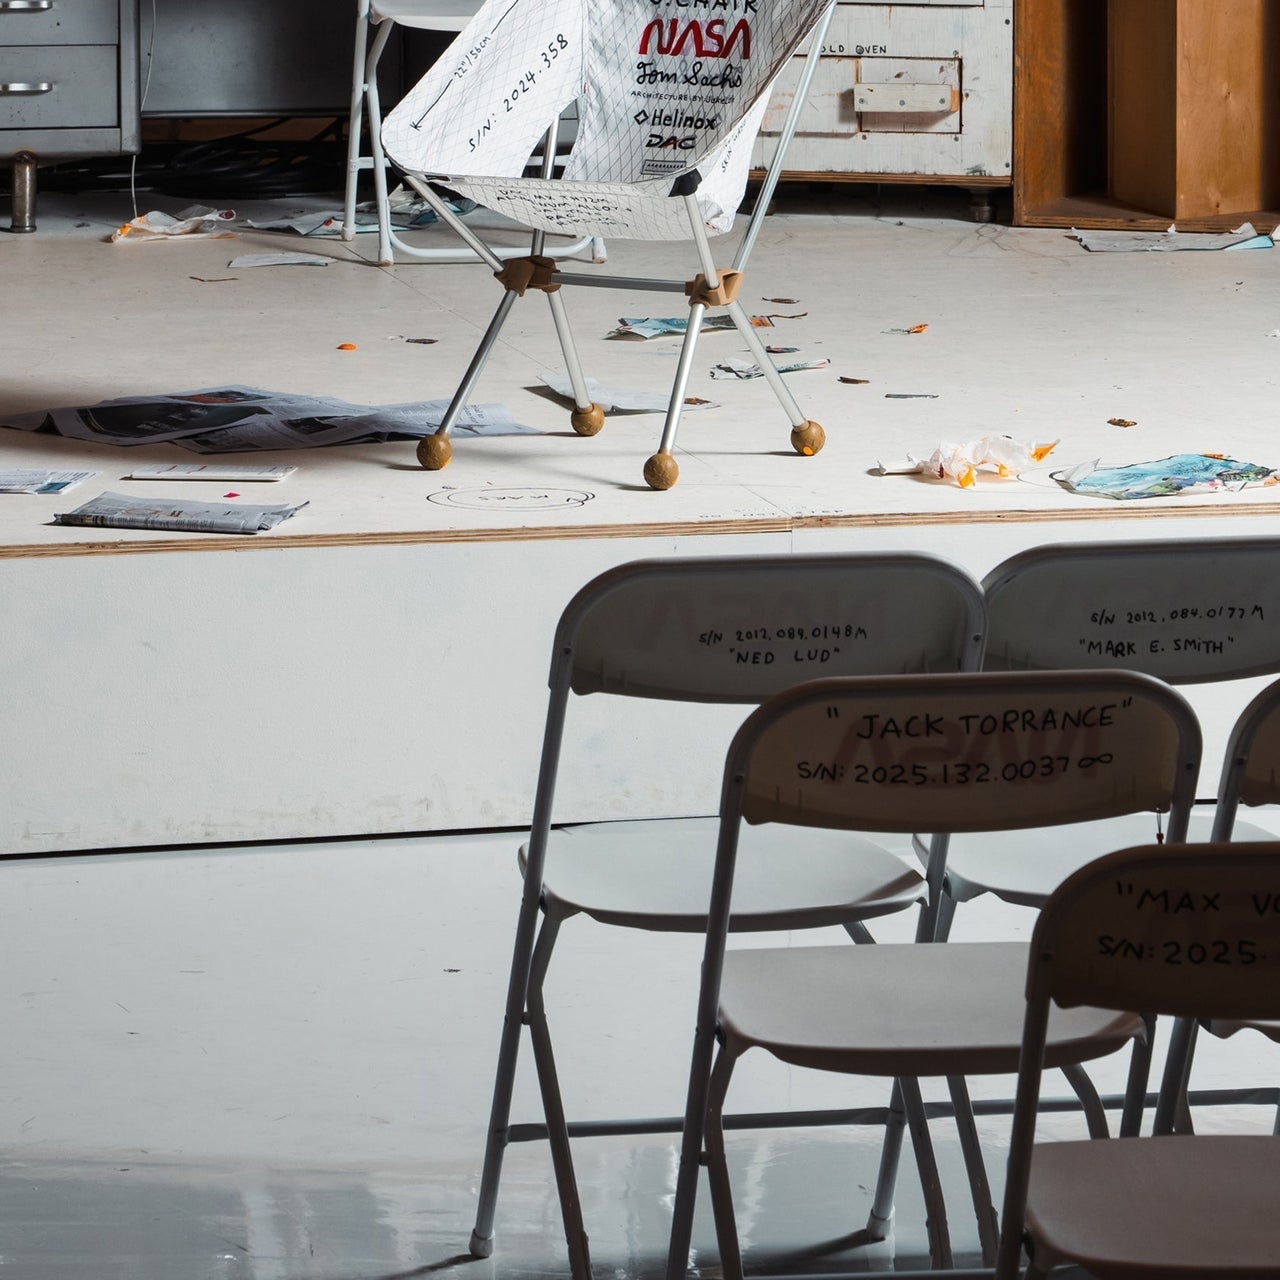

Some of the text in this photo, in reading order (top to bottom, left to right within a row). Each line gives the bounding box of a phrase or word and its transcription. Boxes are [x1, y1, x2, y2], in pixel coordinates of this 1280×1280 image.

[638, 18, 751, 59] NASA
[855, 45, 887, 54] OVEN
[503, 33, 569, 112] 2024.358
[635, 62, 742, 89] Tom Sachs
[630, 90, 687, 102] ARCHITECTURE
[651, 109, 716, 130] Helinox
[645, 134, 696, 149] DAC
[1090, 612, 1114, 625] S/N
[699, 632, 723, 645] S/N
[1149, 641, 1165, 653] E.
